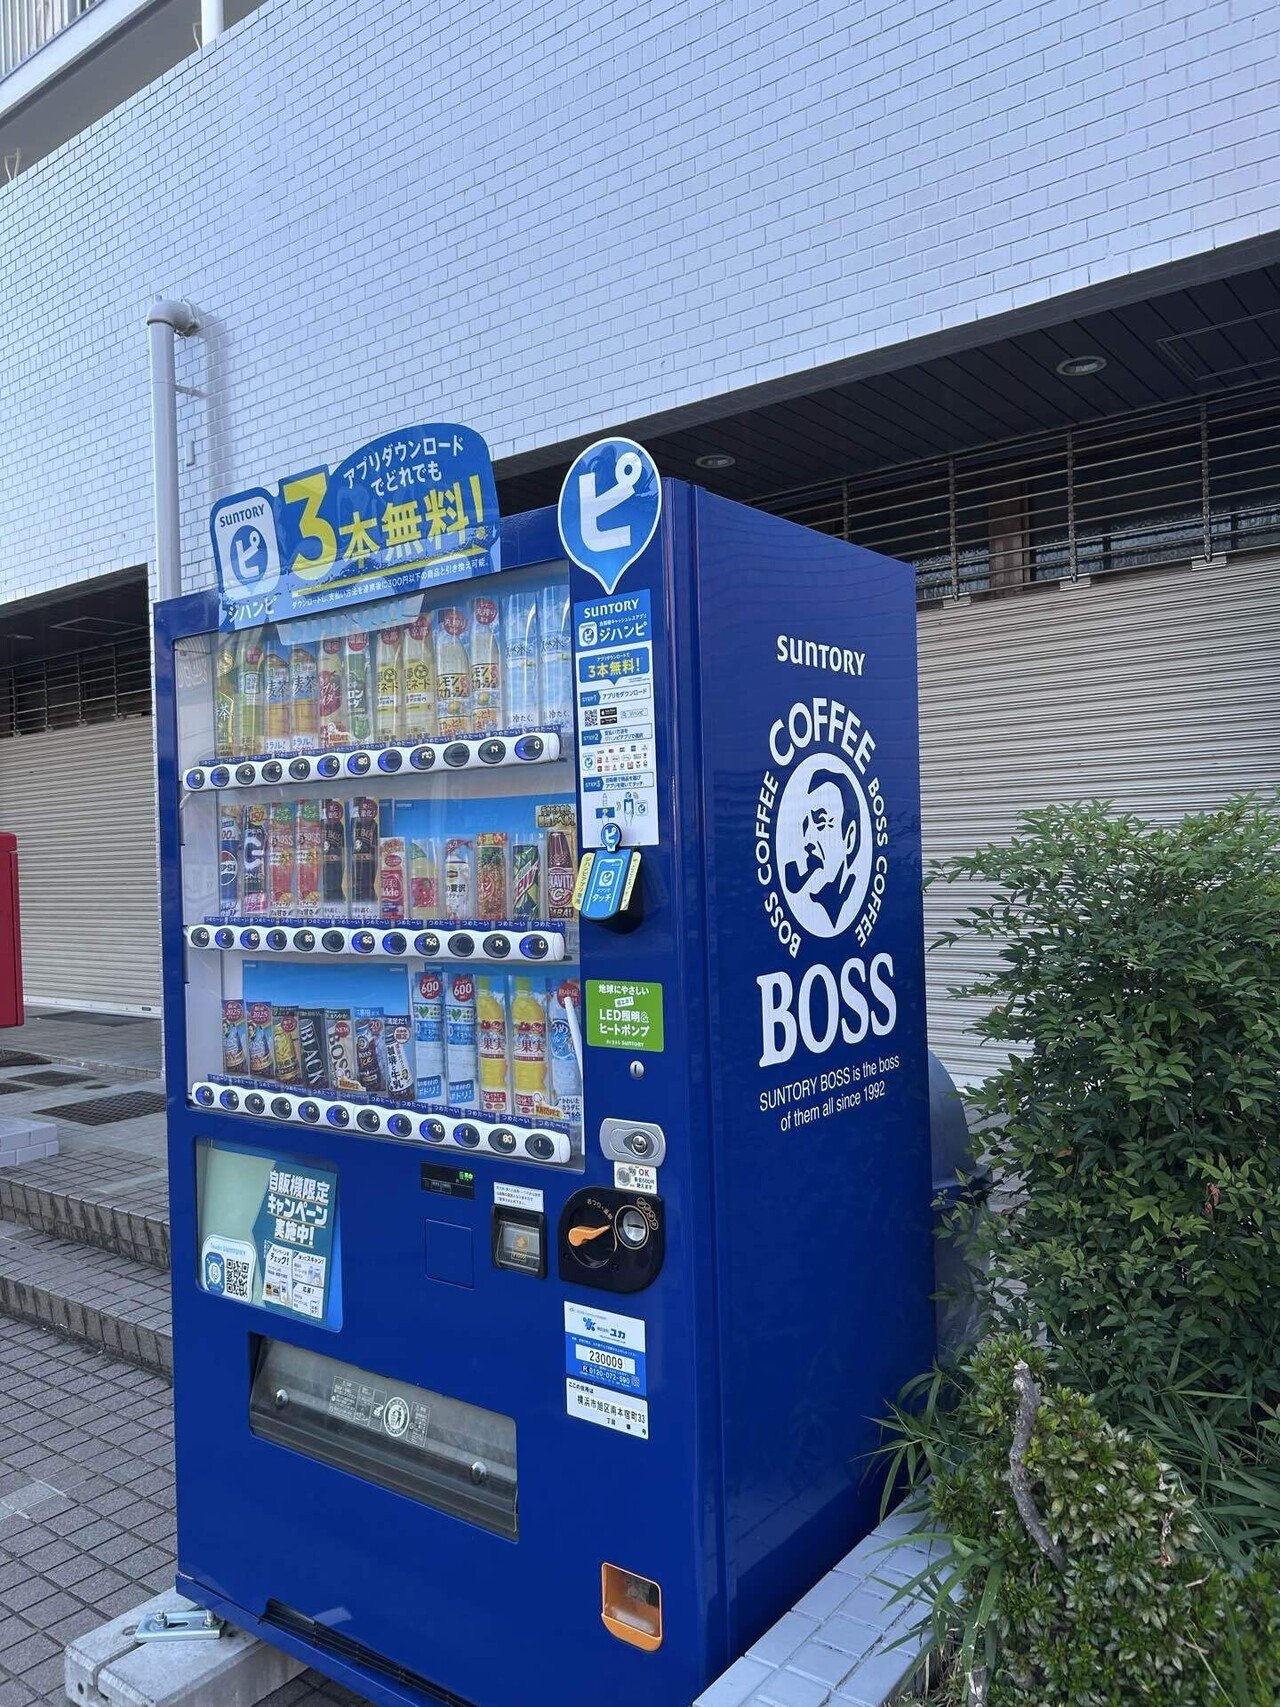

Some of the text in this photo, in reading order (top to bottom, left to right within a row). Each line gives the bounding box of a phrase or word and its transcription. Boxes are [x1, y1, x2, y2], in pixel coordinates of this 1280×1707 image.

[343, 435, 463, 489] アプリダウンロード
[371, 461, 442, 496] でどれでも
[578, 451, 642, 552] ピ
[219, 504, 265, 527] SUNTORY
[283, 473, 488, 581] 3本無料!
[235, 530, 261, 578] ピ
[228, 596, 280, 623] ジハンピ
[584, 598, 639, 618] SUNTORY
[600, 621, 647, 642] ジハンピ
[777, 634, 865, 676] SUNTORY
[588, 658, 640, 678] 3本無料!
[268, 680, 288, 698] 麦茶
[294, 674, 316, 695] 麦茶
[602, 688, 647, 700] アプリをダウンロード
[769, 697, 876, 775] COFFEE
[605, 827, 616, 843] ピ
[755, 770, 801, 959] BOSS COFFEE
[855, 777, 888, 948] BOSS COFFEE
[592, 894, 611, 902] タッチ
[421, 981, 439, 993] 600
[453, 984, 472, 996] 600
[599, 984, 650, 996] 地球にやさしい
[599, 1008, 649, 1023] LED照明&
[756, 952, 897, 1068] BOSS
[336, 1025, 349, 1033] NEW
[599, 1022, 650, 1037] ヒートポンプ
[300, 1027, 325, 1085] BLACK
[759, 1055, 900, 1112] SUNTORY BOSS is the boss
[780, 1080, 886, 1132] of them all since 1992
[638, 1168, 650, 1178] OK
[269, 1170, 330, 1203] 自販機限定
[268, 1193, 327, 1225] キャンペーン
[275, 1218, 314, 1246] 実施中!
[589, 1350, 623, 1370] 230009
